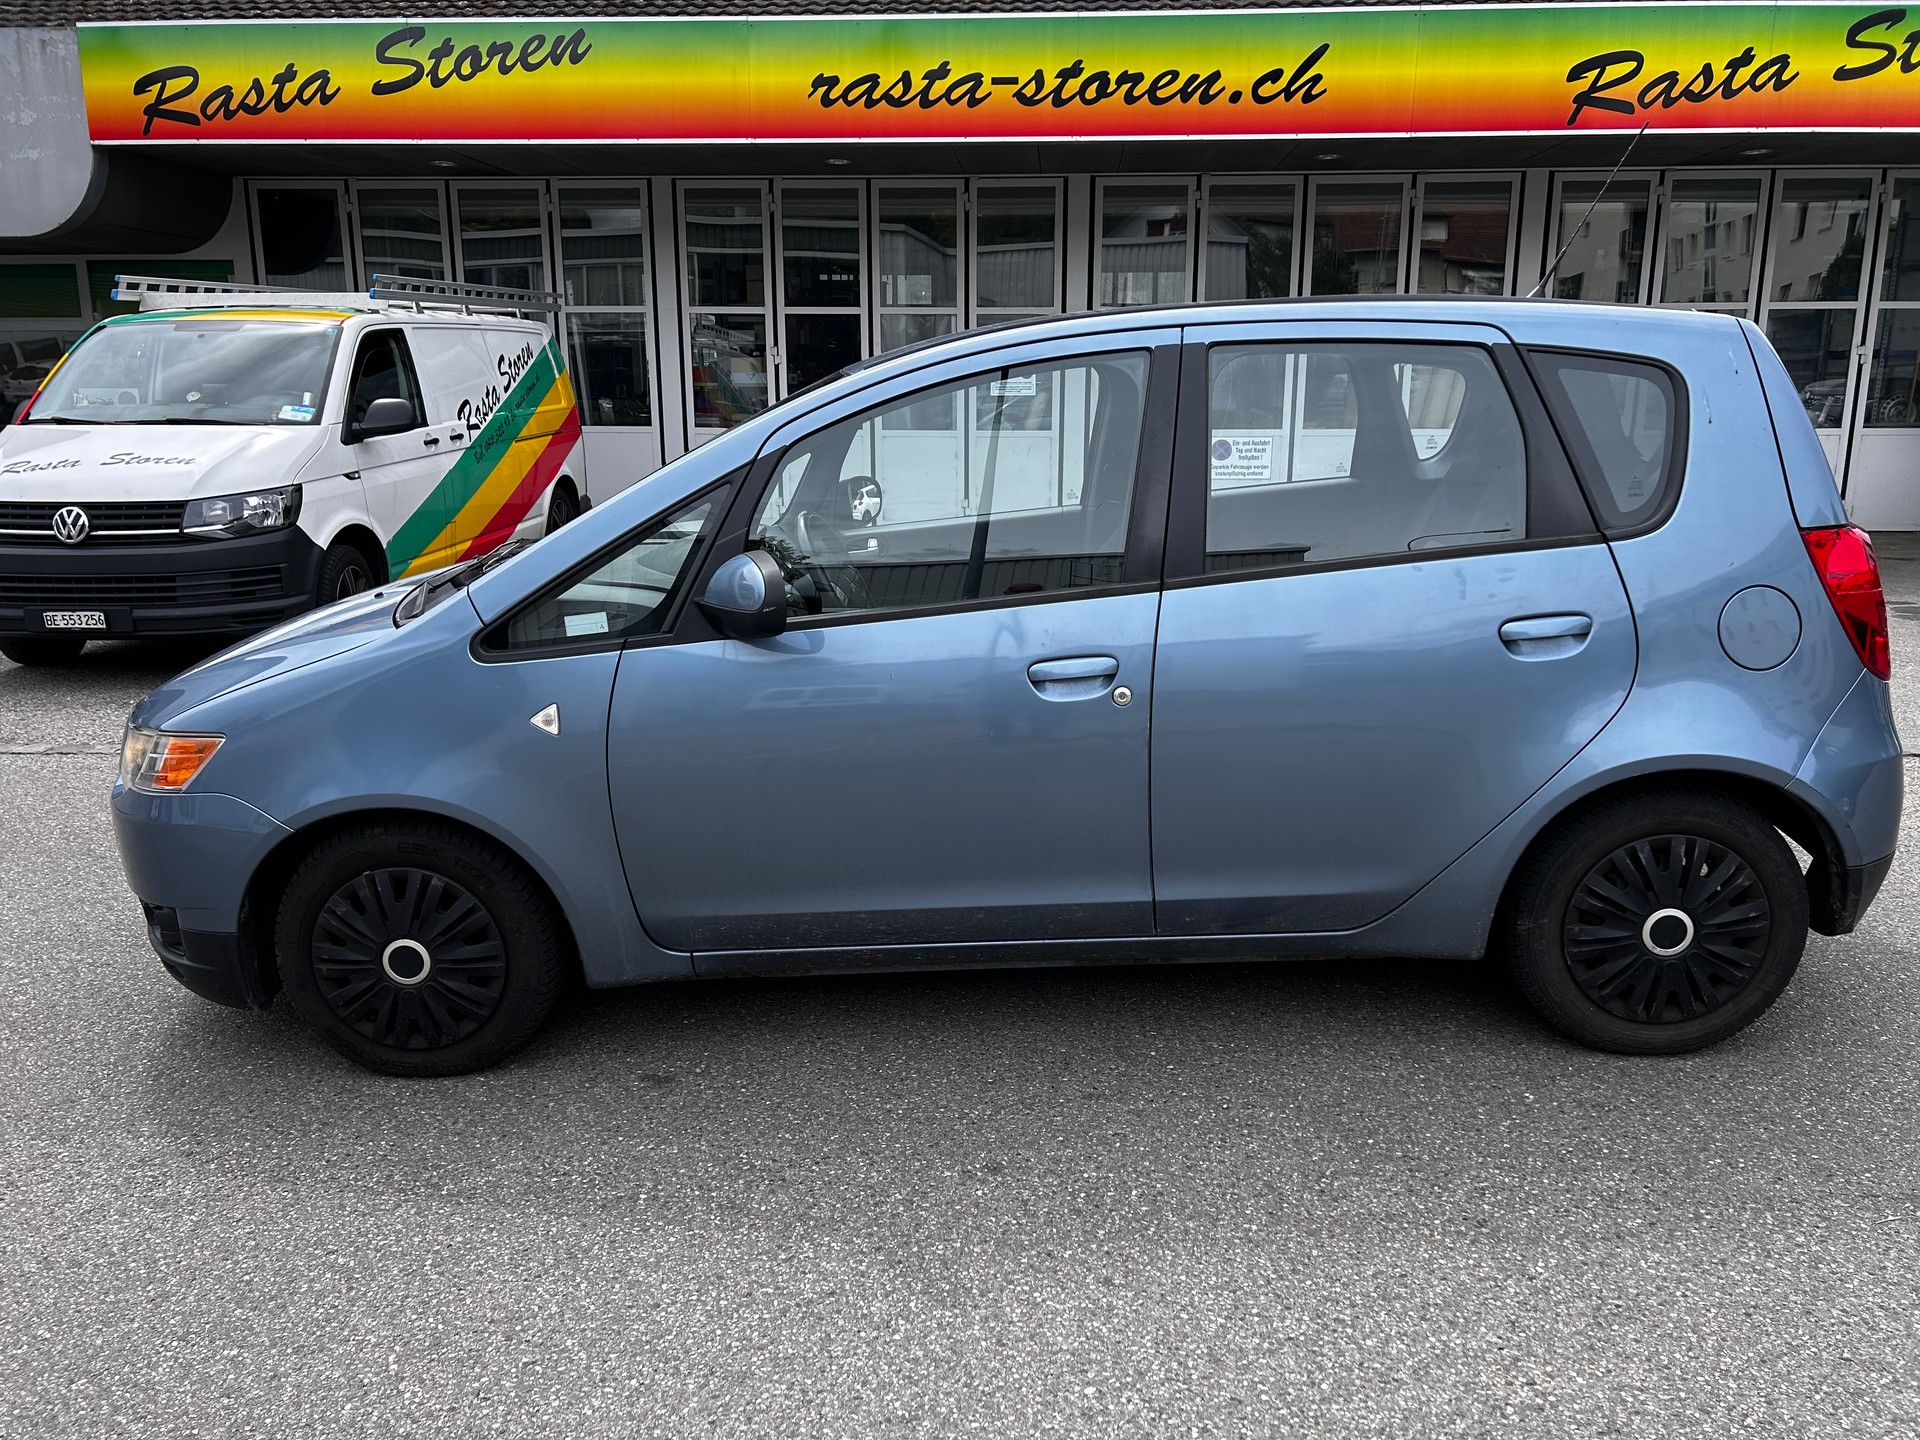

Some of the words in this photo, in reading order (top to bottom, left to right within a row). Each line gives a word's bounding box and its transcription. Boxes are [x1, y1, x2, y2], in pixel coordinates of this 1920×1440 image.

[133, 65, 341, 136] Rasta
[370, 26, 593, 96] Storen
[807, 43, 1330, 109] rasta-storen.ch
[1565, 50, 1800, 127] Rasta
[457, 385, 501, 442] Rasta
[497, 341, 534, 394] Storen
[0, 459, 82, 476] Rasta
[100, 452, 196, 466] Storen
